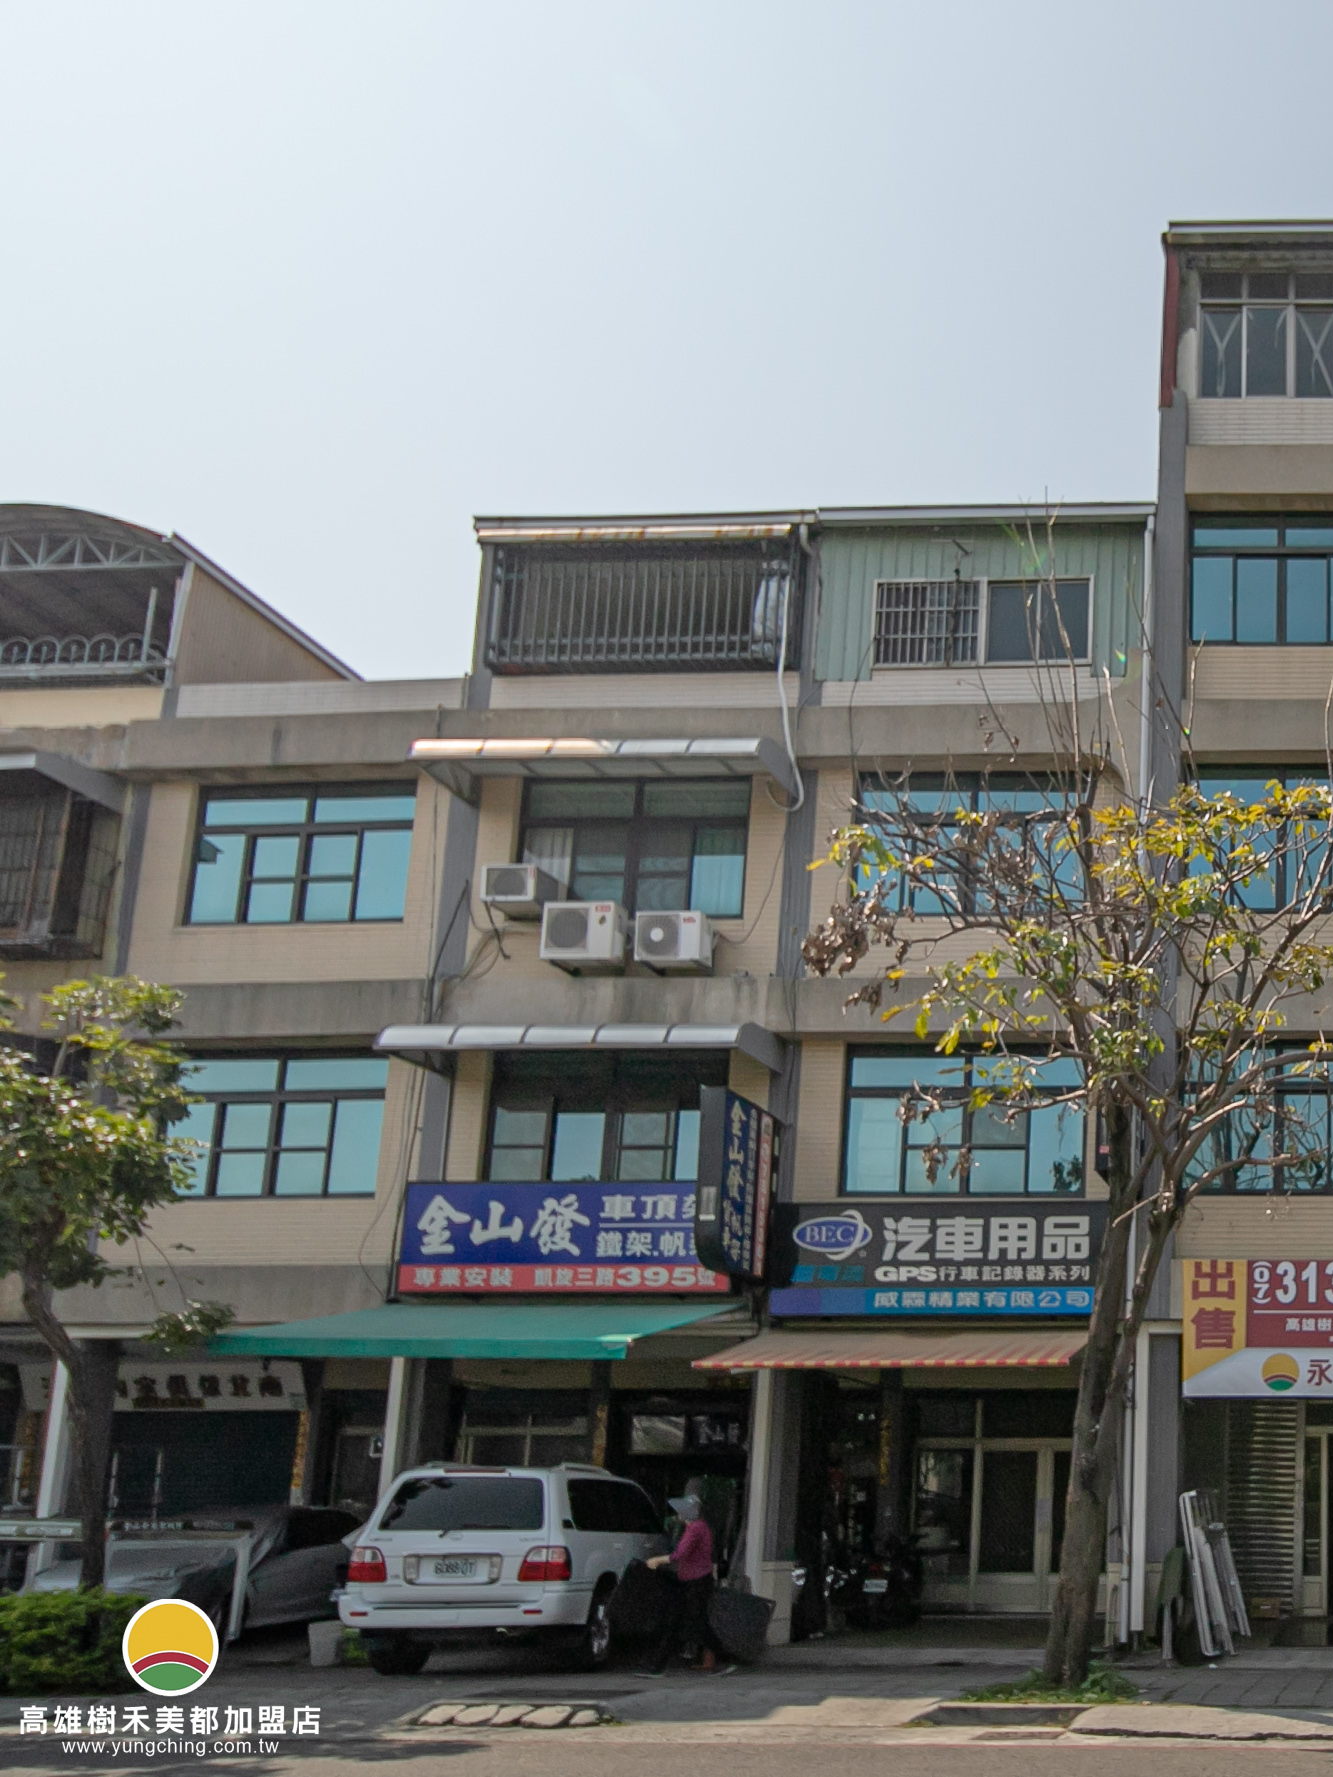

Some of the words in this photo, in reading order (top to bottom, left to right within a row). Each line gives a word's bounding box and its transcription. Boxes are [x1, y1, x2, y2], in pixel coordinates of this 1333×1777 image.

[417, 1193, 591, 1256] 金山發
[596, 1230, 697, 1257] 鐵架.帆
[882, 1216, 1090, 1262] 汽車用品
[1191, 1259, 1236, 1350] 出售
